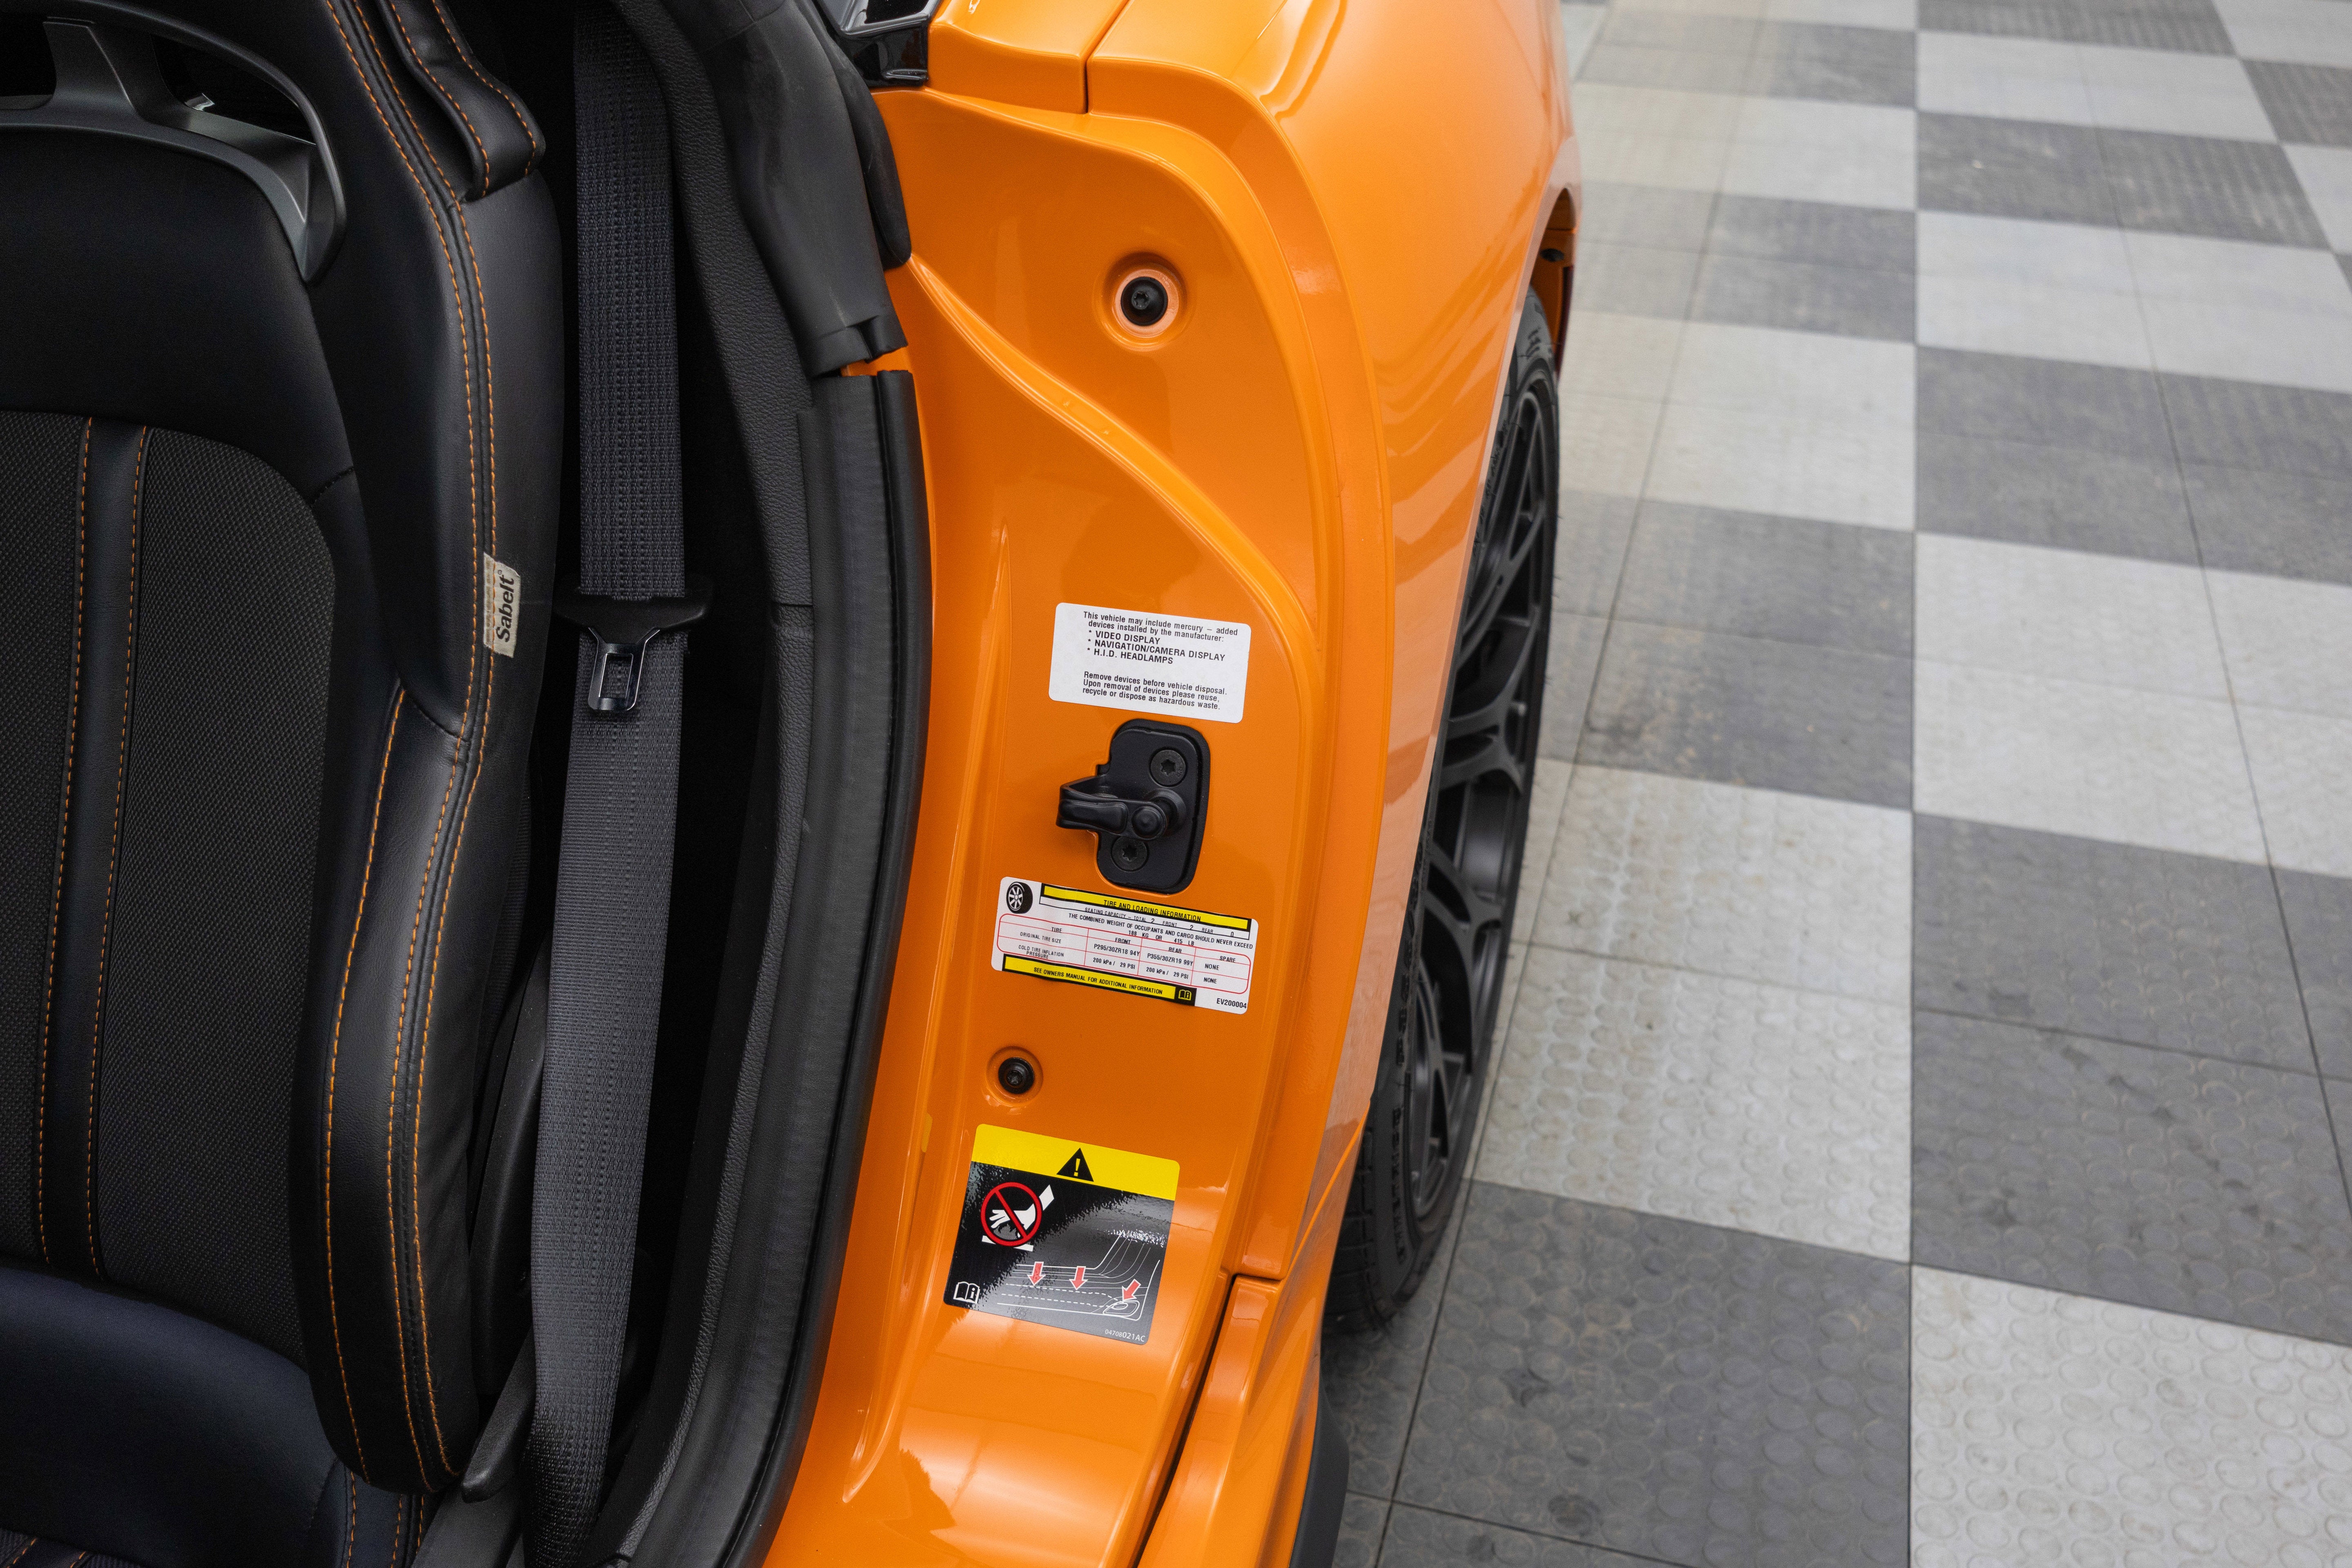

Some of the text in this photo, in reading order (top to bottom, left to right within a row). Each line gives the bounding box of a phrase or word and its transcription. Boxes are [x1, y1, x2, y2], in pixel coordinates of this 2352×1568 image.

[495, 575, 515, 643] Sabelt
[1083, 611, 1098, 619] This
[1101, 614, 1125, 623] vehicle
[1128, 618, 1143, 626] may
[1145, 618, 1171, 628] include
[1174, 623, 1203, 633] mercury
[1216, 627, 1238, 635] added
[1088, 620, 1115, 629] devices
[1117, 623, 1147, 633] installed
[1150, 627, 1158, 636] by
[1174, 631, 1224, 642] manufacturer:
[1096, 630, 1160, 644] VIDEO DISPLAY
[1094, 648, 1173, 664] H.I.D. HEADLAMPS
[1095, 639, 1225, 661] NAVIGATION/CAMERA DISPLAY
[1083, 679, 1101, 687] Upon
[1104, 683, 1131, 691] removal
[1143, 686, 1169, 696] devices
[1172, 690, 1195, 699] please
[1084, 671, 1227, 695] Remove devices before vehicle disposal.
[1082, 686, 1107, 696] recycle
[1119, 691, 1146, 701] dispose
[1159, 696, 1195, 706] hazardous
[1085, 907, 1104, 915] SEATING
[1104, 911, 1127, 919] CAPACITY
[1132, 904, 1159, 915] LOADING
[1160, 909, 1201, 922] INFORMATION
[1080, 915, 1105, 924] COMBINED
[1134, 924, 1163, 934] OCCUPANTS
[1195, 935, 1214, 943] SHOULD
[1094, 944, 1128, 954] P295/30ZR18
[1114, 937, 1131, 945] FRONT
[1025, 951, 1050, 959] PRESSURE
[1147, 953, 1182, 964] P355/30ZR19
[1219, 955, 1236, 963] SPARE
[1066, 973, 1085, 981] MANUAL
[1099, 979, 1127, 988] ADDITIONAL
[1129, 984, 1163, 994] INFORMATION
[1216, 998, 1247, 1009] EV200004
[1105, 1329, 1146, 1342] 04708021AC
